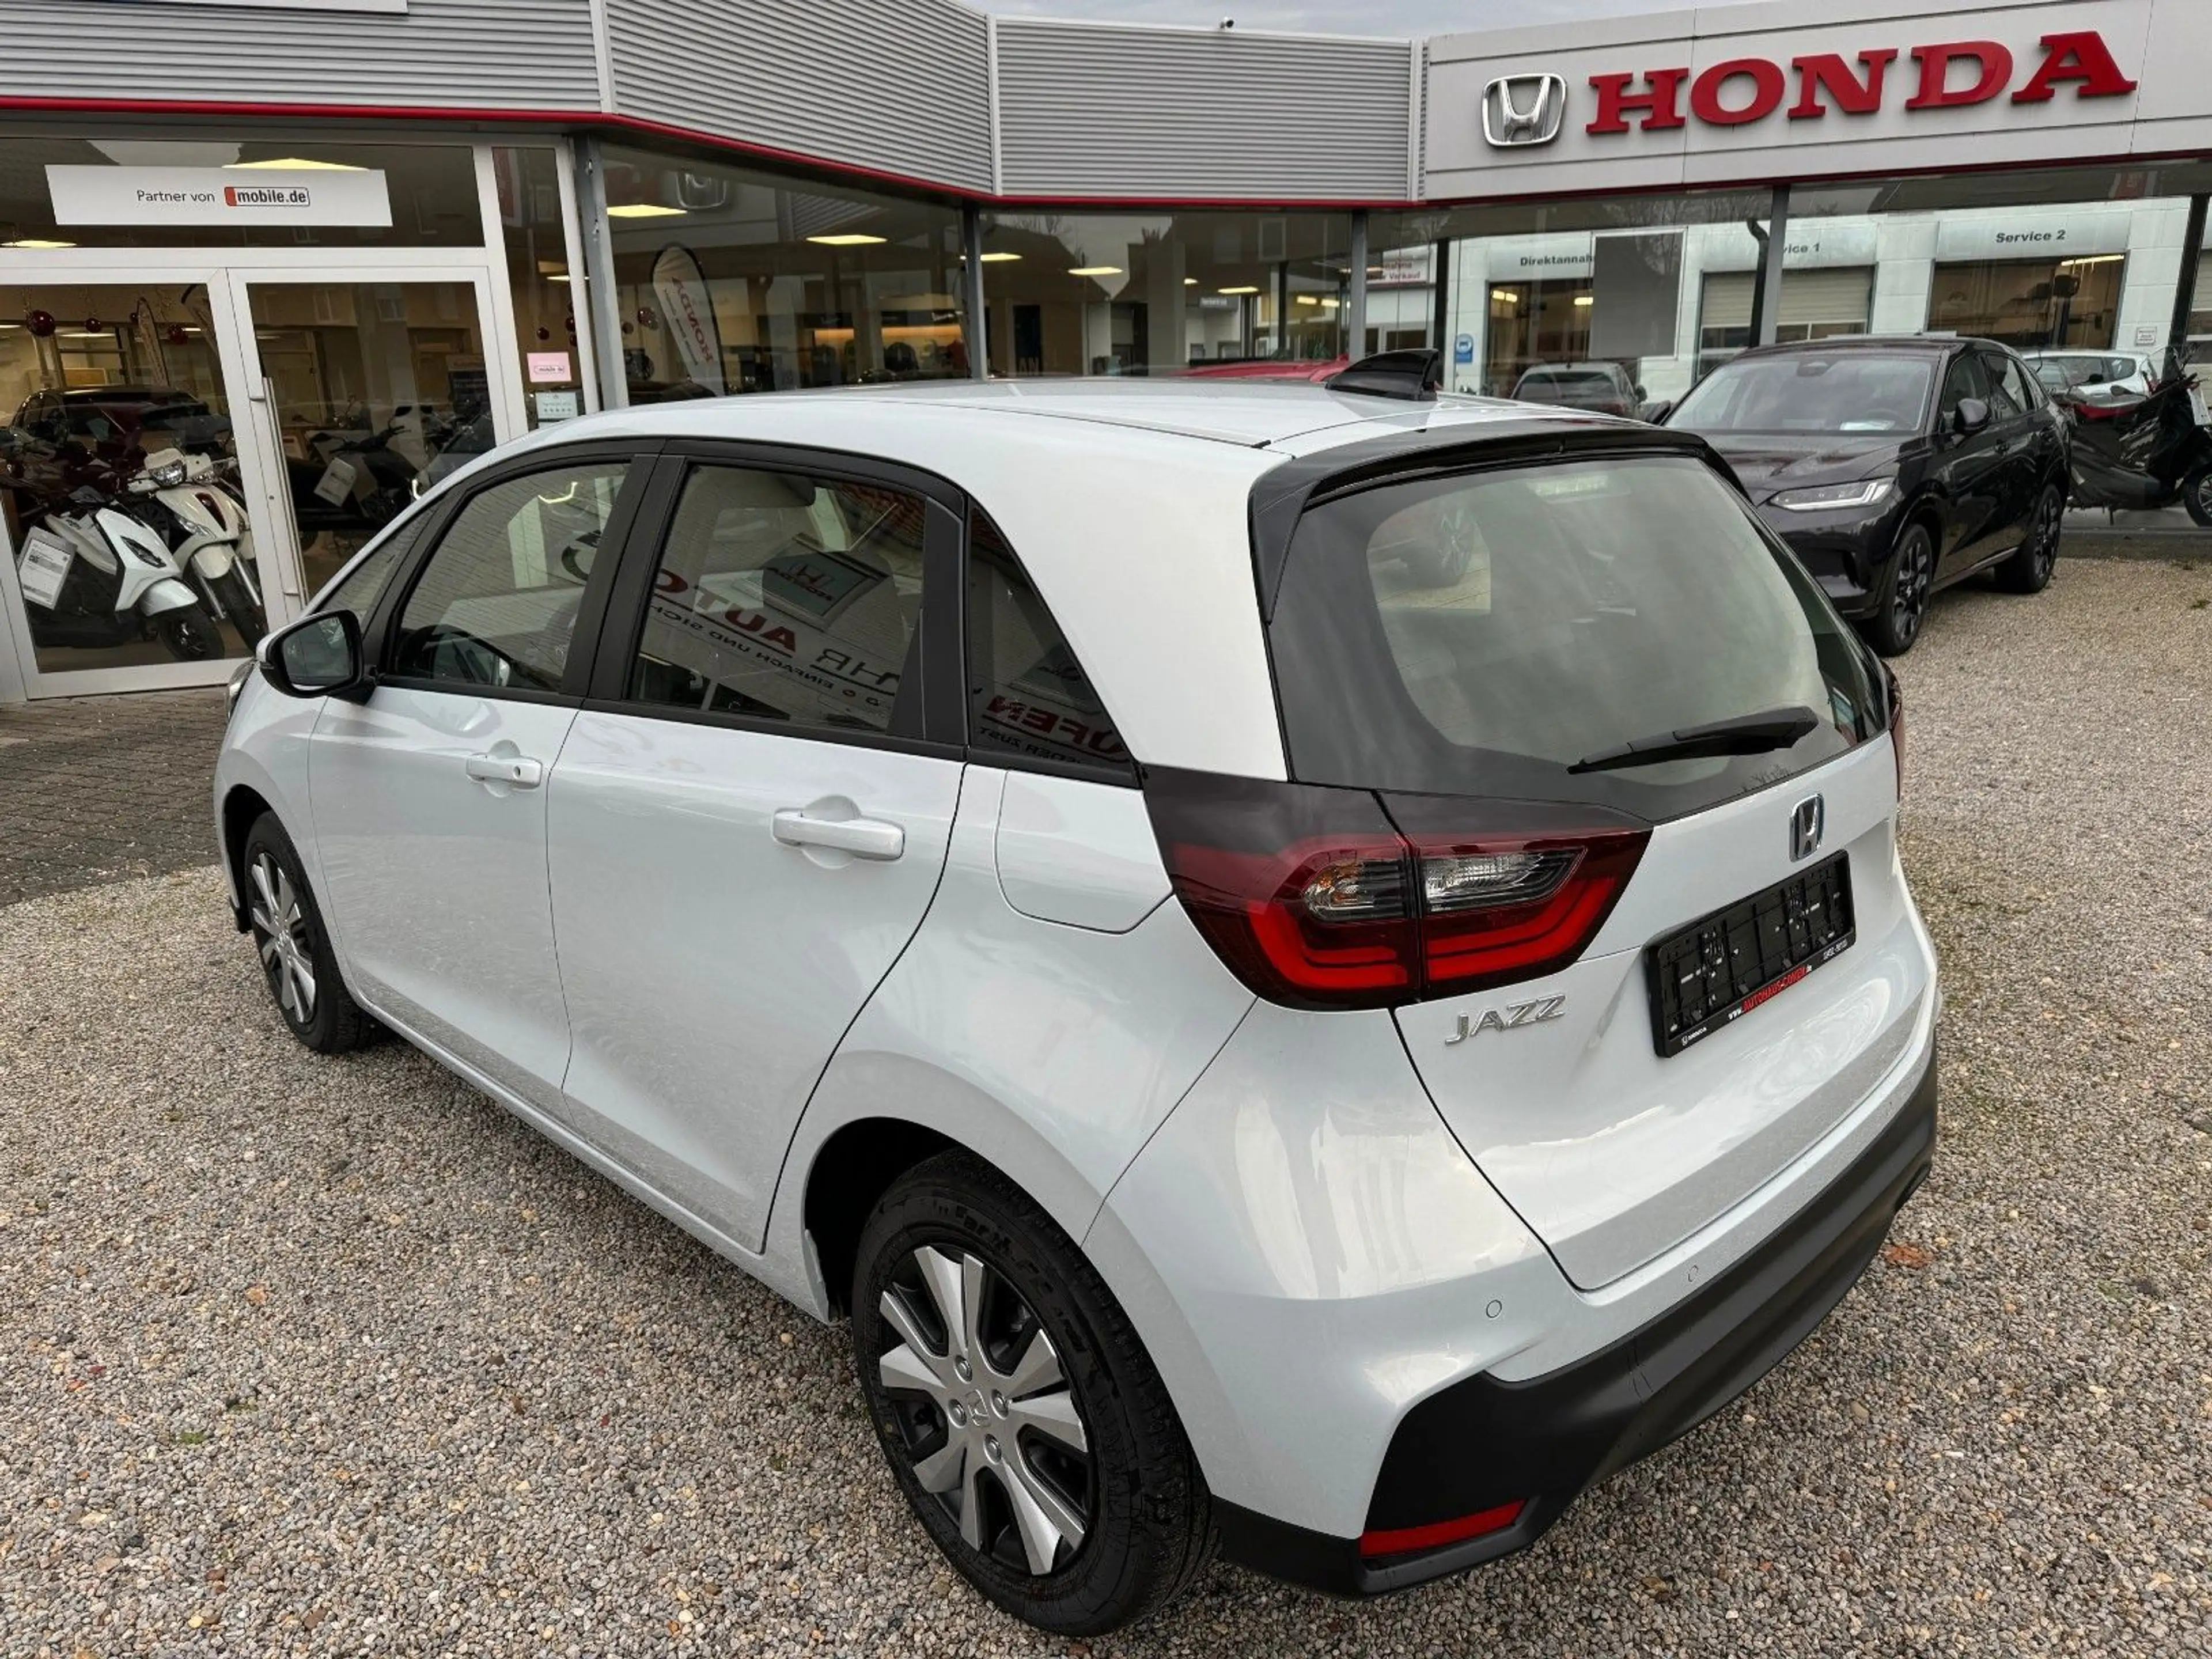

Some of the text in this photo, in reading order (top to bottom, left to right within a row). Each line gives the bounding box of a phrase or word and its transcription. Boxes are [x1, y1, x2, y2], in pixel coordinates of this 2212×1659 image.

[1586, 30, 2138, 135] HONDA
[137, 189, 307, 203] Partner von mobile.de
[1995, 229, 2066, 244] Service 2
[1812, 242, 1820, 252] 1
[1445, 994, 1566, 1046] JAZZ
